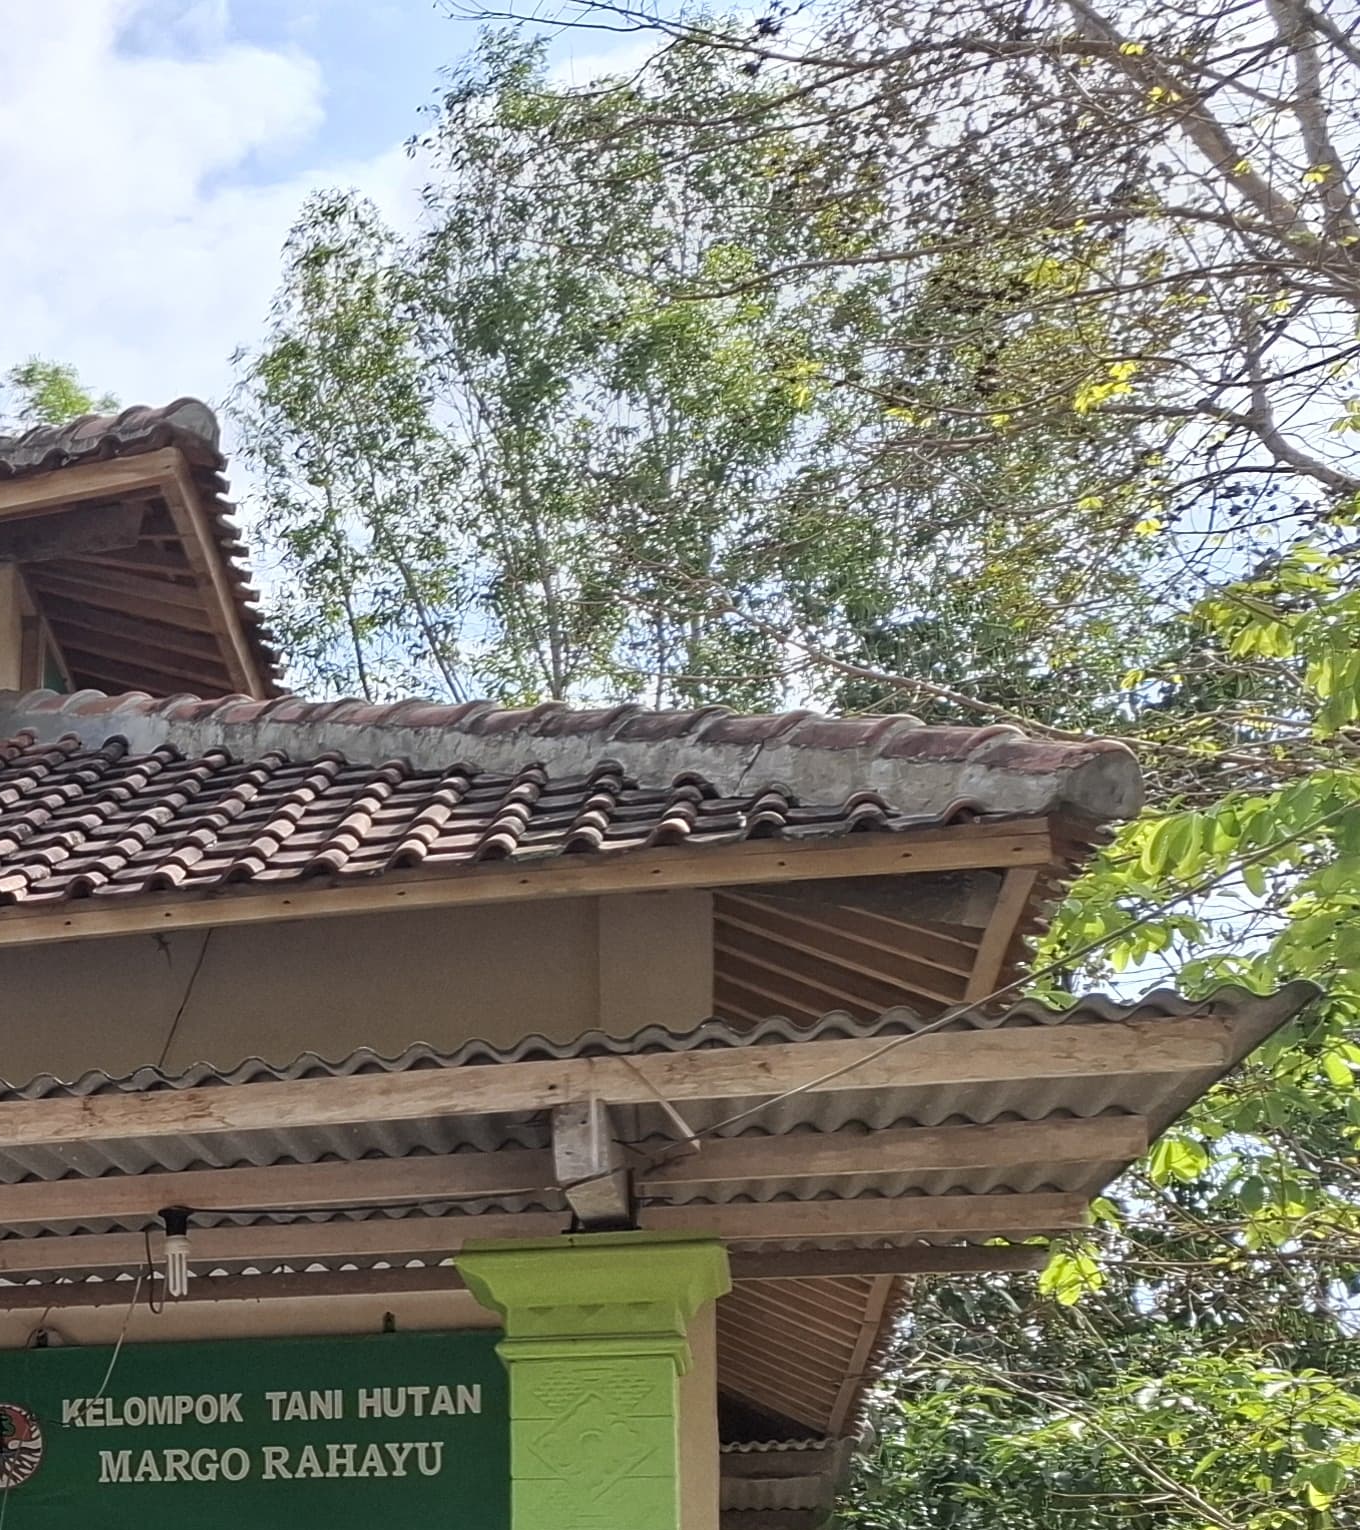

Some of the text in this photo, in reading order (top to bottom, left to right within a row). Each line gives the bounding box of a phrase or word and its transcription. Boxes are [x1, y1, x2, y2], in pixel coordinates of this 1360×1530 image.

[62, 1384, 481, 1428] KELOMPOK TANI HUTAN
[99, 1442, 444, 1483] MARGO RAHAYU
